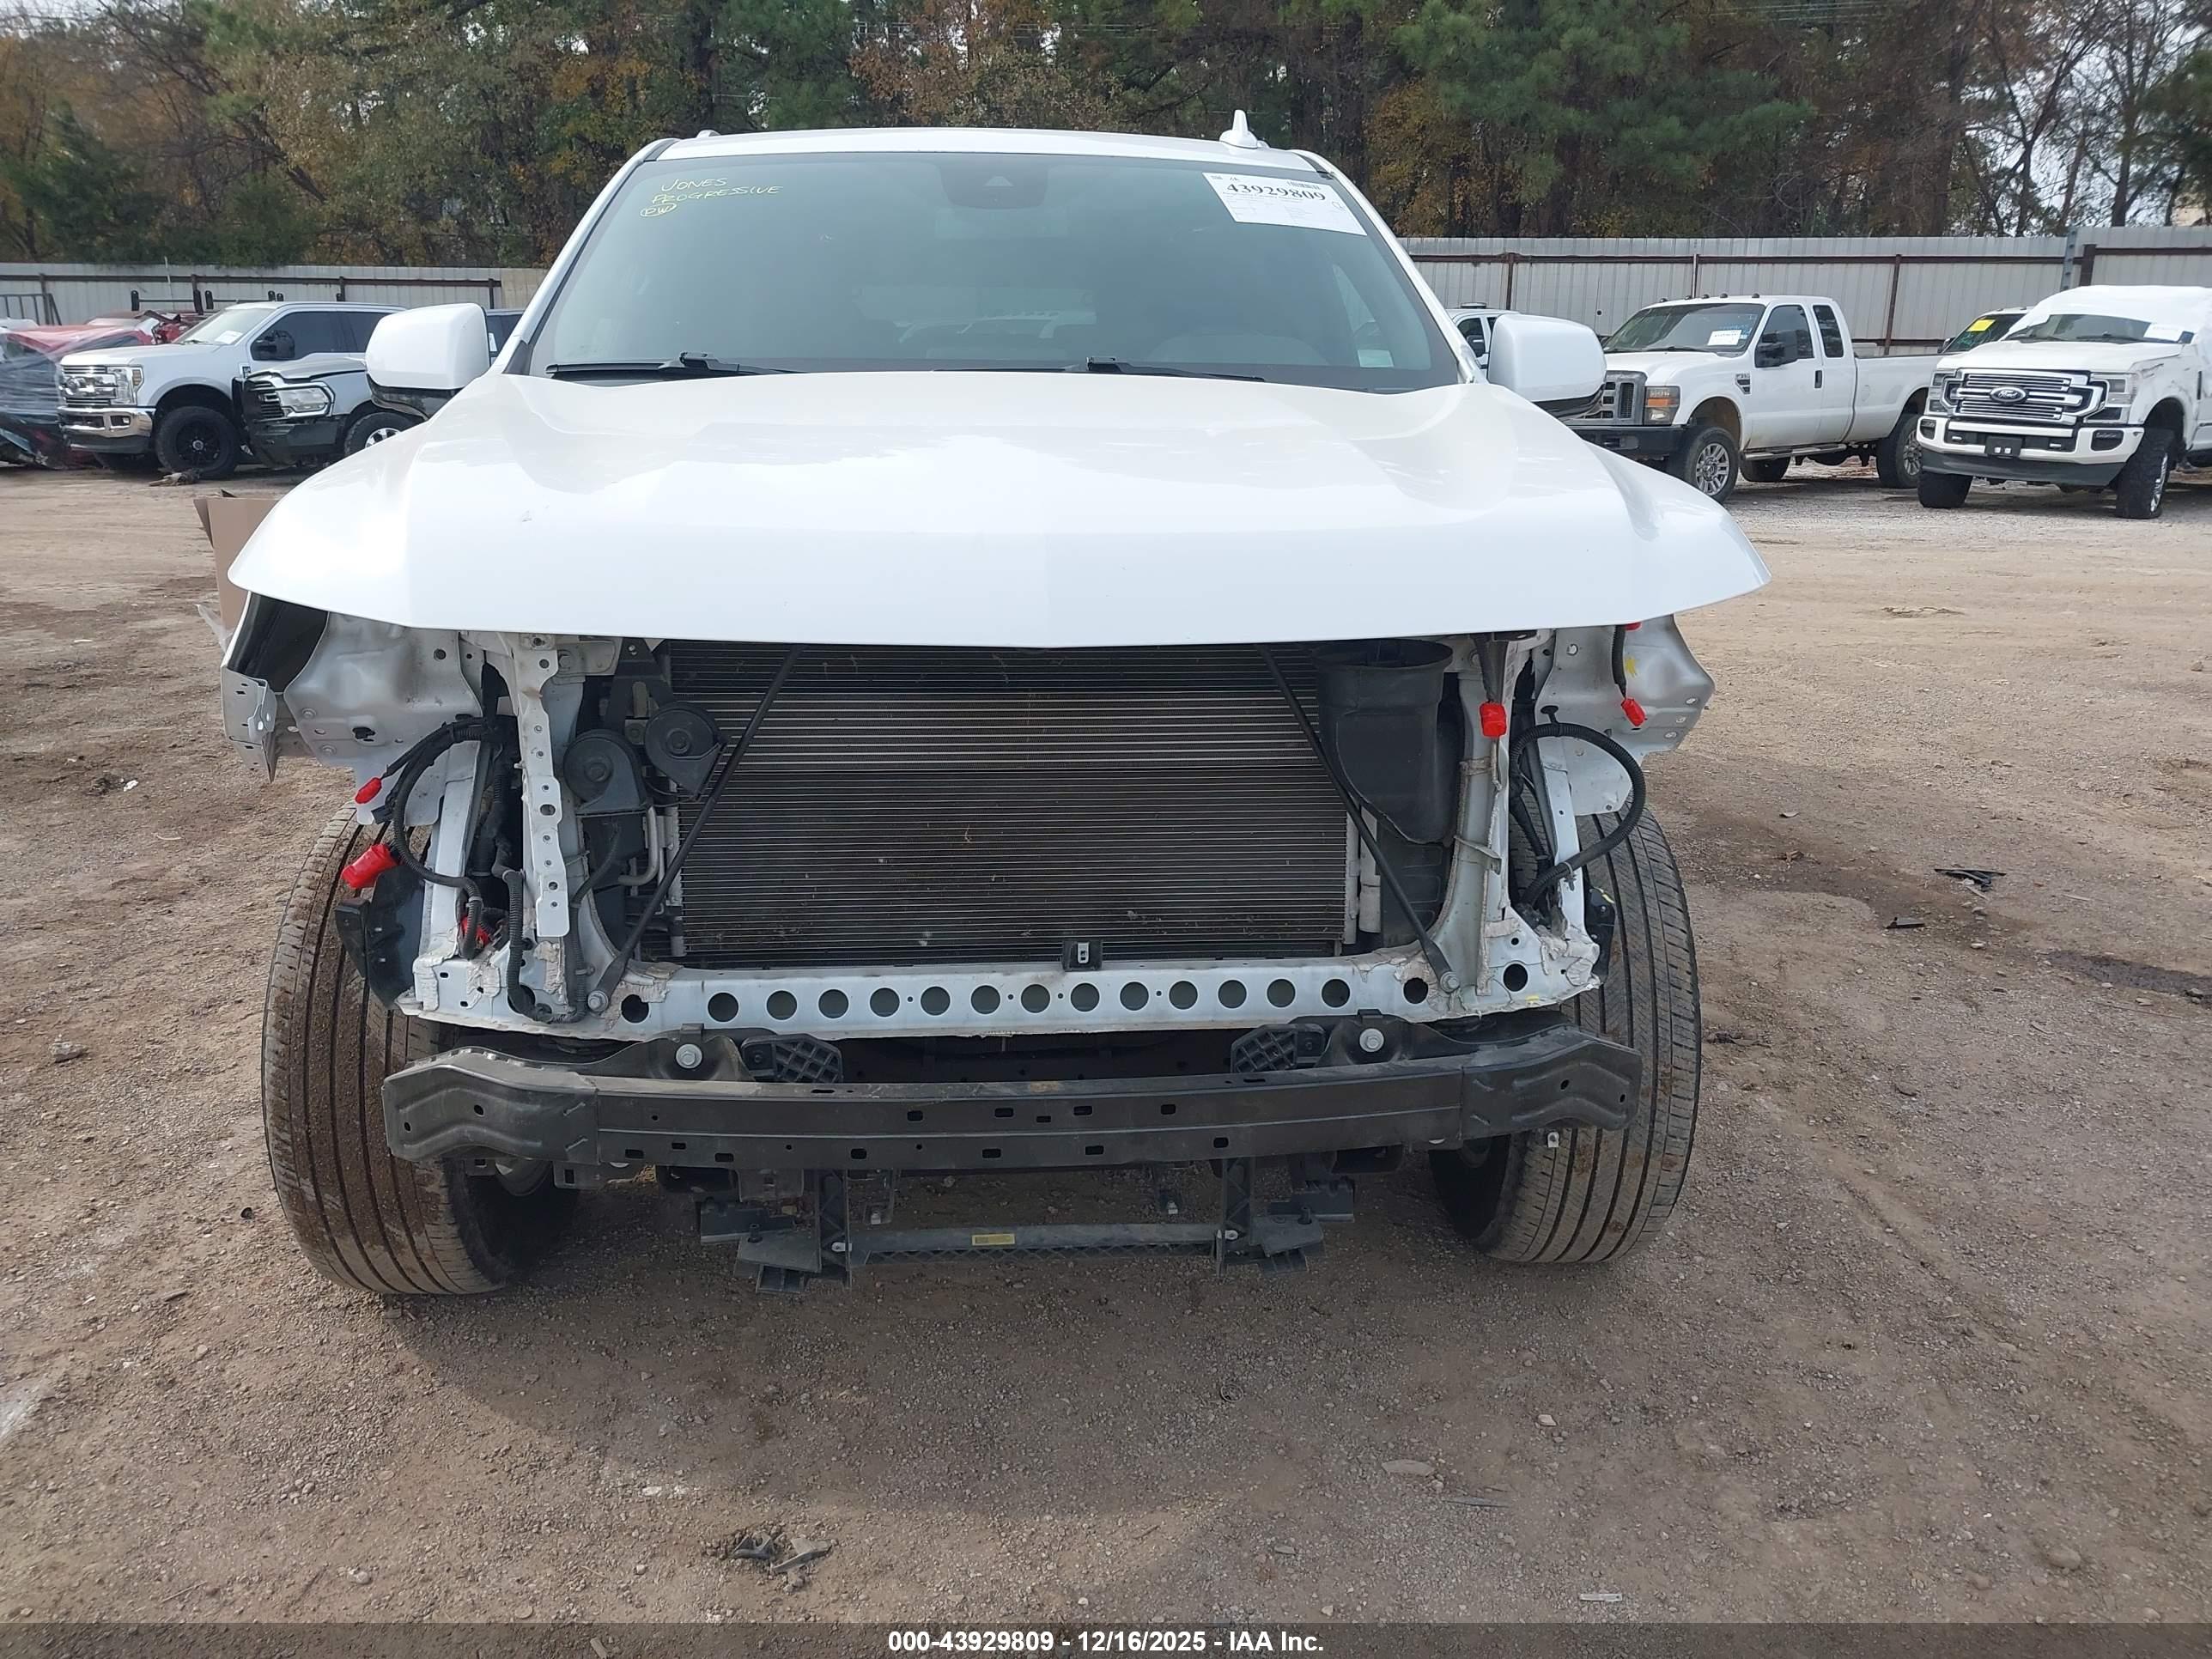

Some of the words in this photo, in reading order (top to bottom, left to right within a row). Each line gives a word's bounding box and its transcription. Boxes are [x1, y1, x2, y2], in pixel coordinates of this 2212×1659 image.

[661, 178, 728, 191] JONES
[1227, 183, 1327, 201] 43929809
[653, 185, 783, 204] PROGRESSIVE
